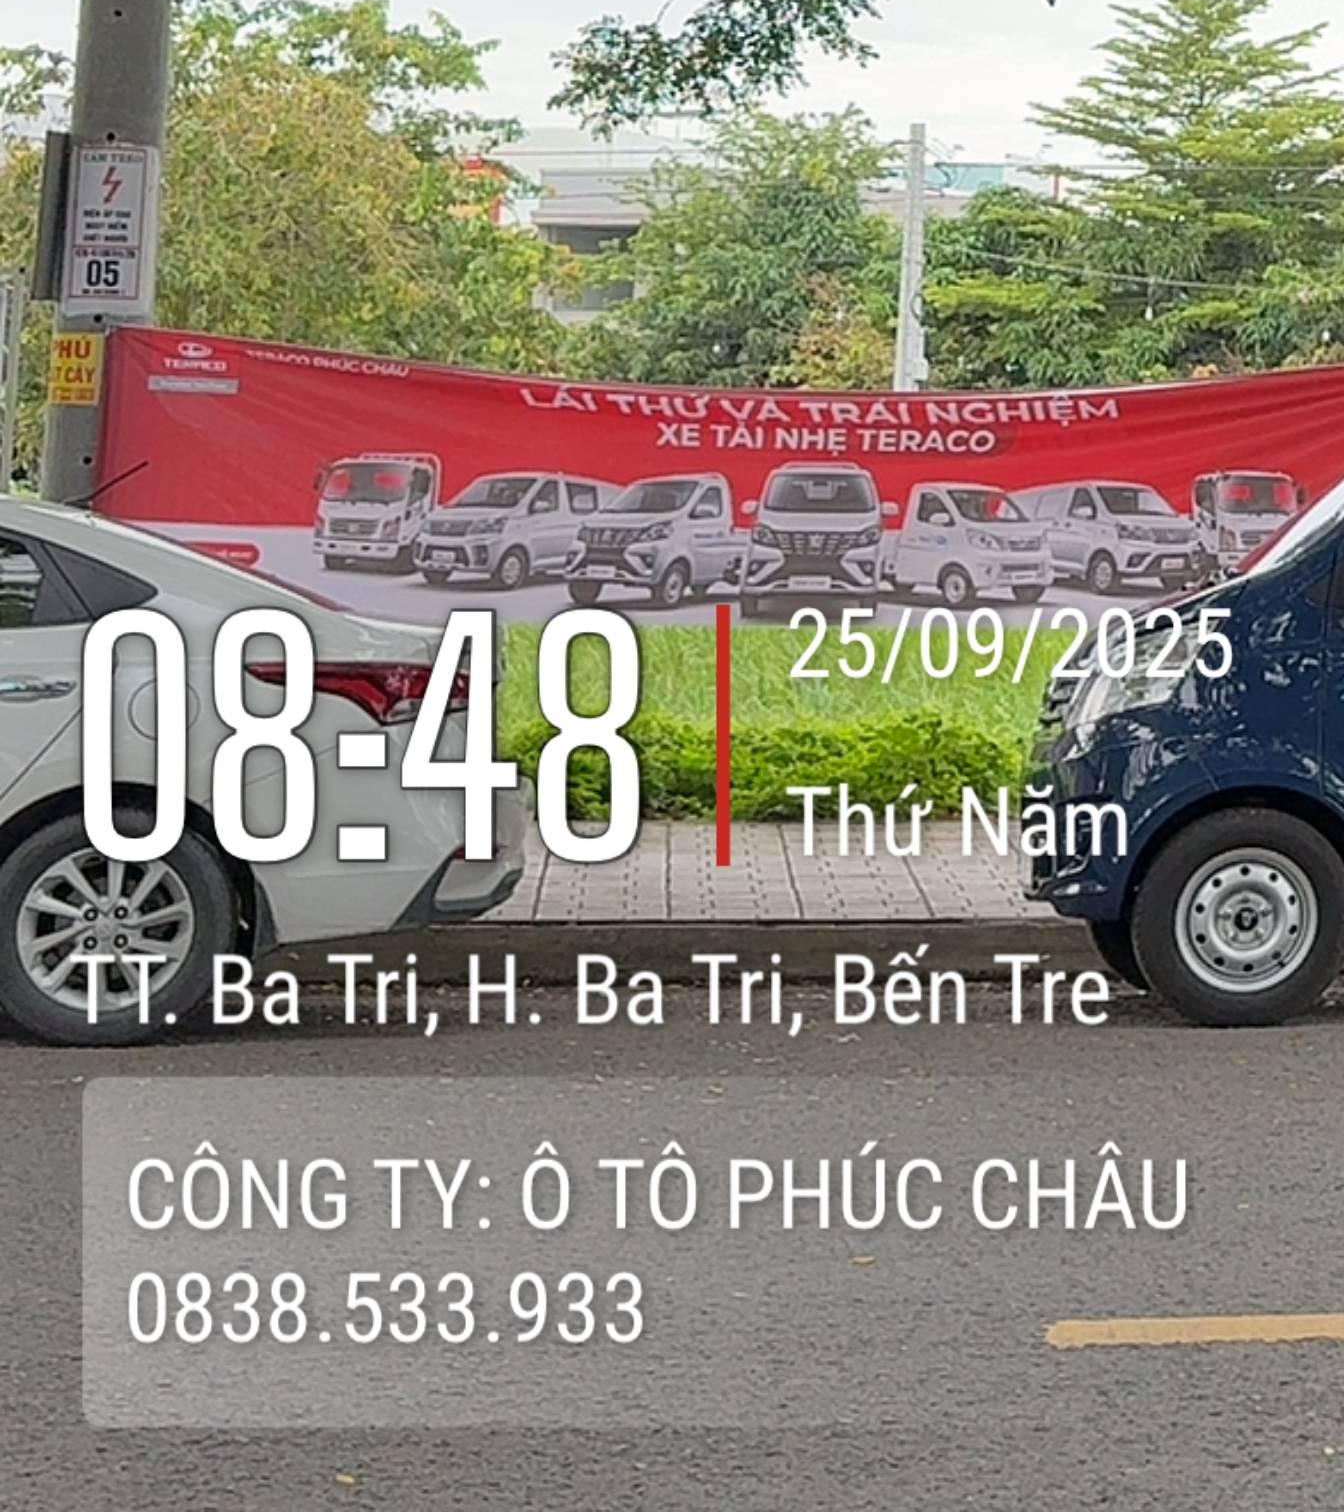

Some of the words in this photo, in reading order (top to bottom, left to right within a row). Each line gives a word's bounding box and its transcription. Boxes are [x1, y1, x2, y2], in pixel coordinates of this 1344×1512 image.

[86, 260, 120, 287] 05
[656, 421, 701, 448] XE
[773, 426, 847, 456] NHẸ
[856, 427, 996, 454] TERACO
